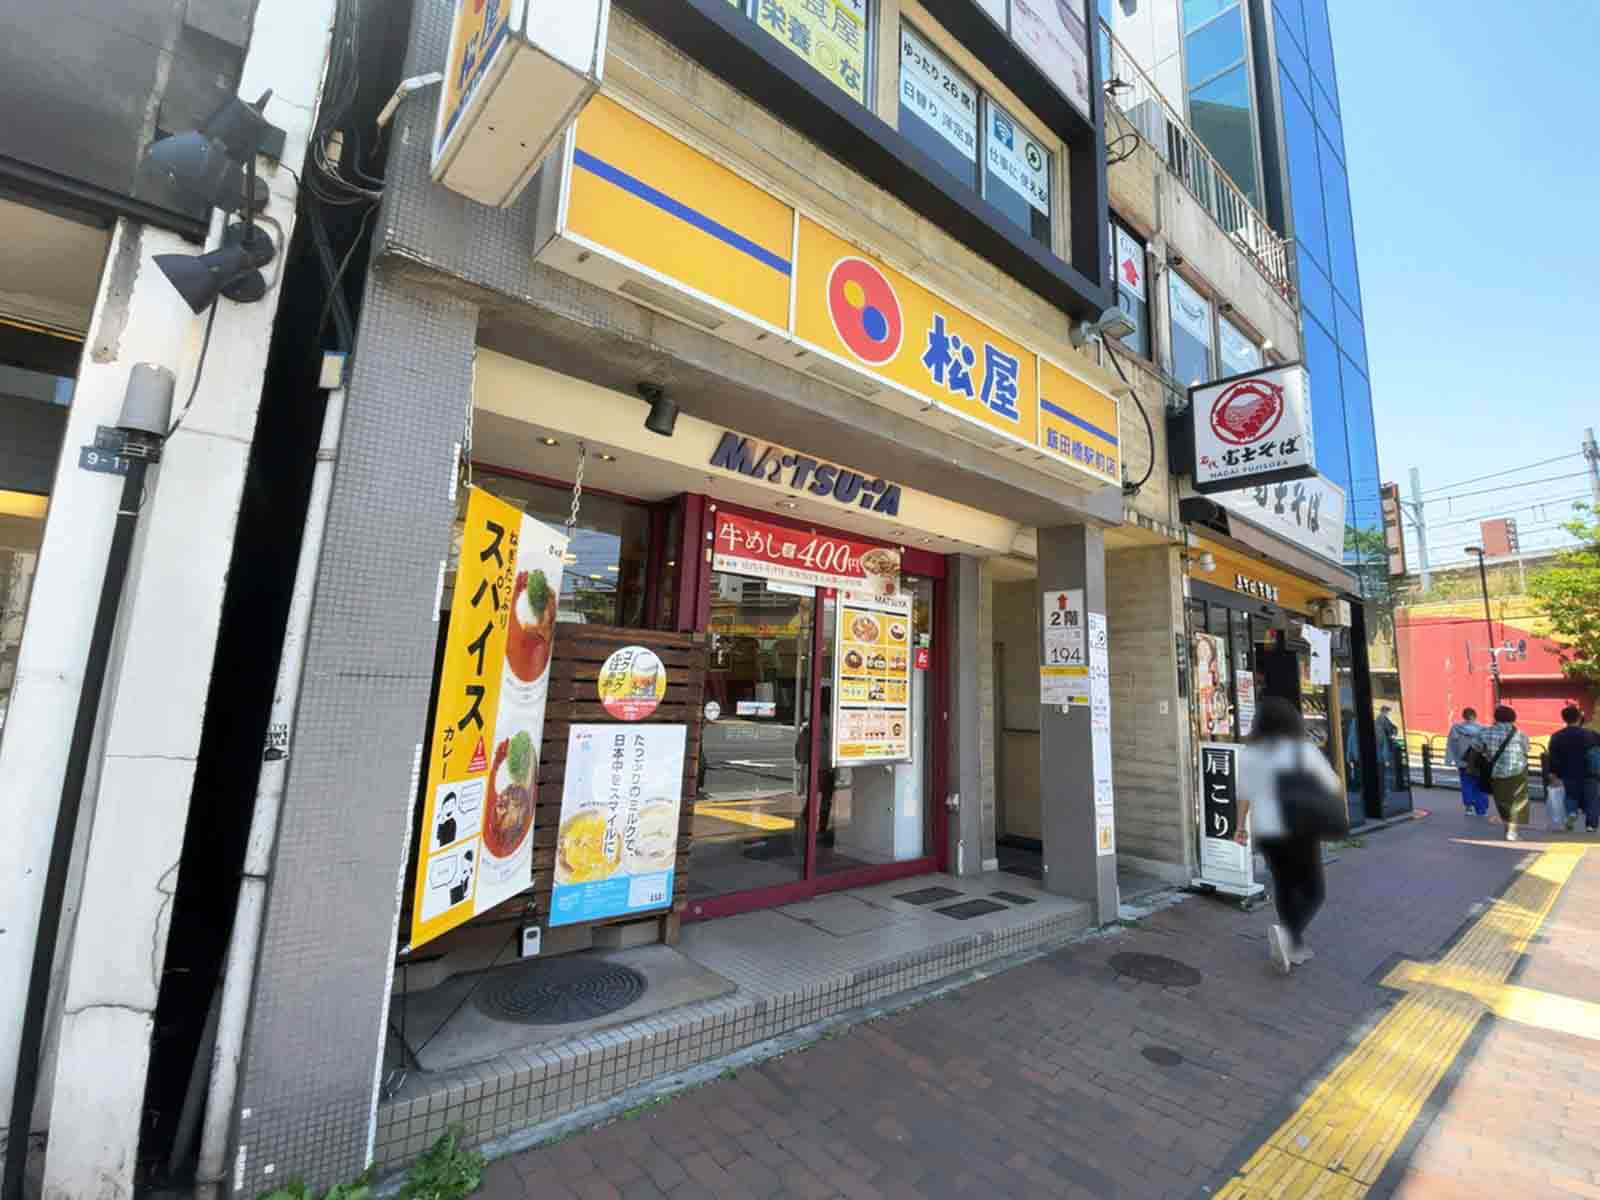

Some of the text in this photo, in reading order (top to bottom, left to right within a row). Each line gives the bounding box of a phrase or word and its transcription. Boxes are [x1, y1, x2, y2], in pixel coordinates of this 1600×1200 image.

[904, 40, 939, 80] ゆったり
[922, 313, 1019, 422] 松屋
[1221, 434, 1302, 466] 富士そば
[458, 519, 506, 732] スパイス
[1050, 610, 1079, 626] 2階
[1050, 647, 1081, 663] 194
[442, 726, 455, 780] カレー
[1206, 751, 1230, 837] 肩こり
